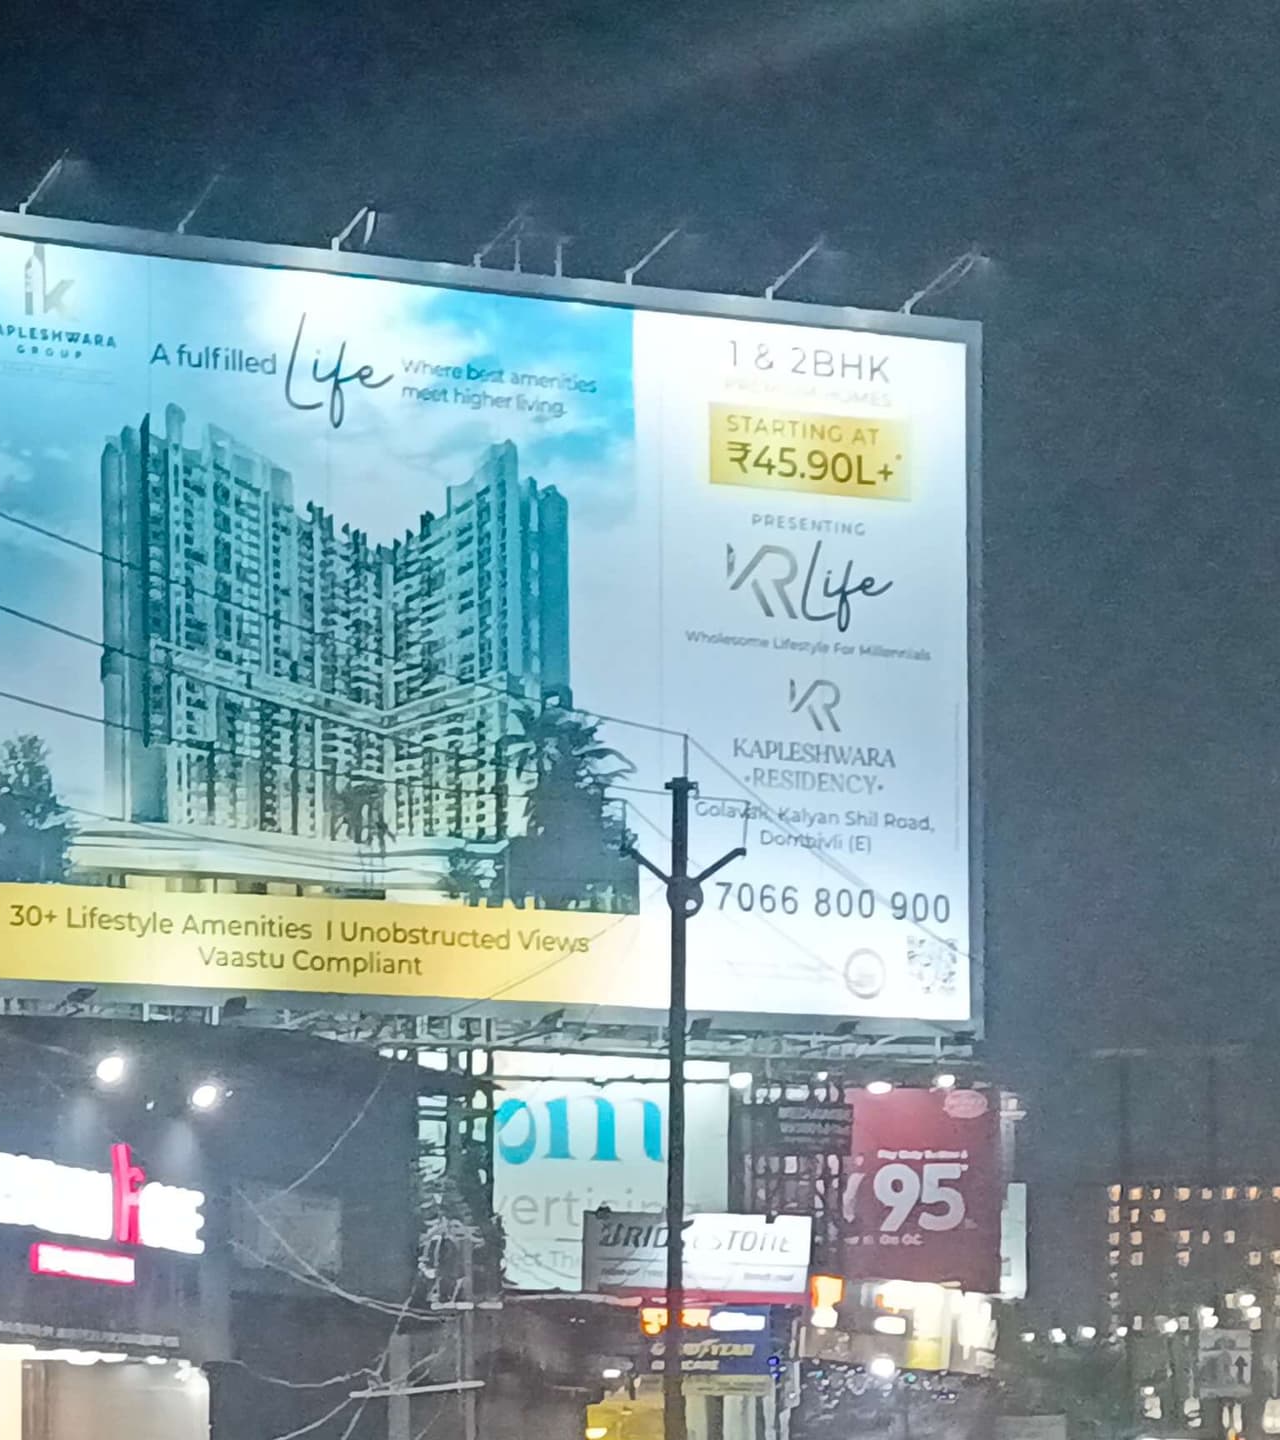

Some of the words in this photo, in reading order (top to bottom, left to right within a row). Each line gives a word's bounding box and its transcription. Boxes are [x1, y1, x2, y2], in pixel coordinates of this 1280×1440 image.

[16, 344, 83, 360] GROUP
[754, 343, 774, 370] &
[791, 347, 890, 384] 2BHK
[150, 344, 170, 366] A
[177, 345, 277, 375] fulfilled
[285, 312, 395, 428] Life
[402, 357, 462, 379] Where
[510, 370, 597, 393] amenities
[402, 385, 448, 403] meet
[454, 387, 512, 410] higher
[726, 414, 842, 443] STARTING
[851, 428, 880, 446] AT
[751, 513, 866, 537] PRESENTING
[801, 540, 894, 632] Life
[685, 629, 770, 648] Wholesome
[773, 637, 830, 656] Lifestyle
[834, 641, 856, 656] For
[733, 738, 896, 769] KAPLESHWARA
[778, 806, 841, 830] Kalyan
[884, 812, 936, 834] Road,
[715, 881, 800, 916] 7066
[814, 887, 876, 919] 800
[890, 891, 952, 924] 900
[9, 904, 58, 929] 30+
[66, 906, 174, 937] Lifestyle
[181, 912, 314, 942] Amenities
[340, 921, 511, 952] Unobstructed
[517, 931, 591, 954] Views
[197, 946, 286, 973] Vaastu
[292, 949, 424, 977] Compliant
